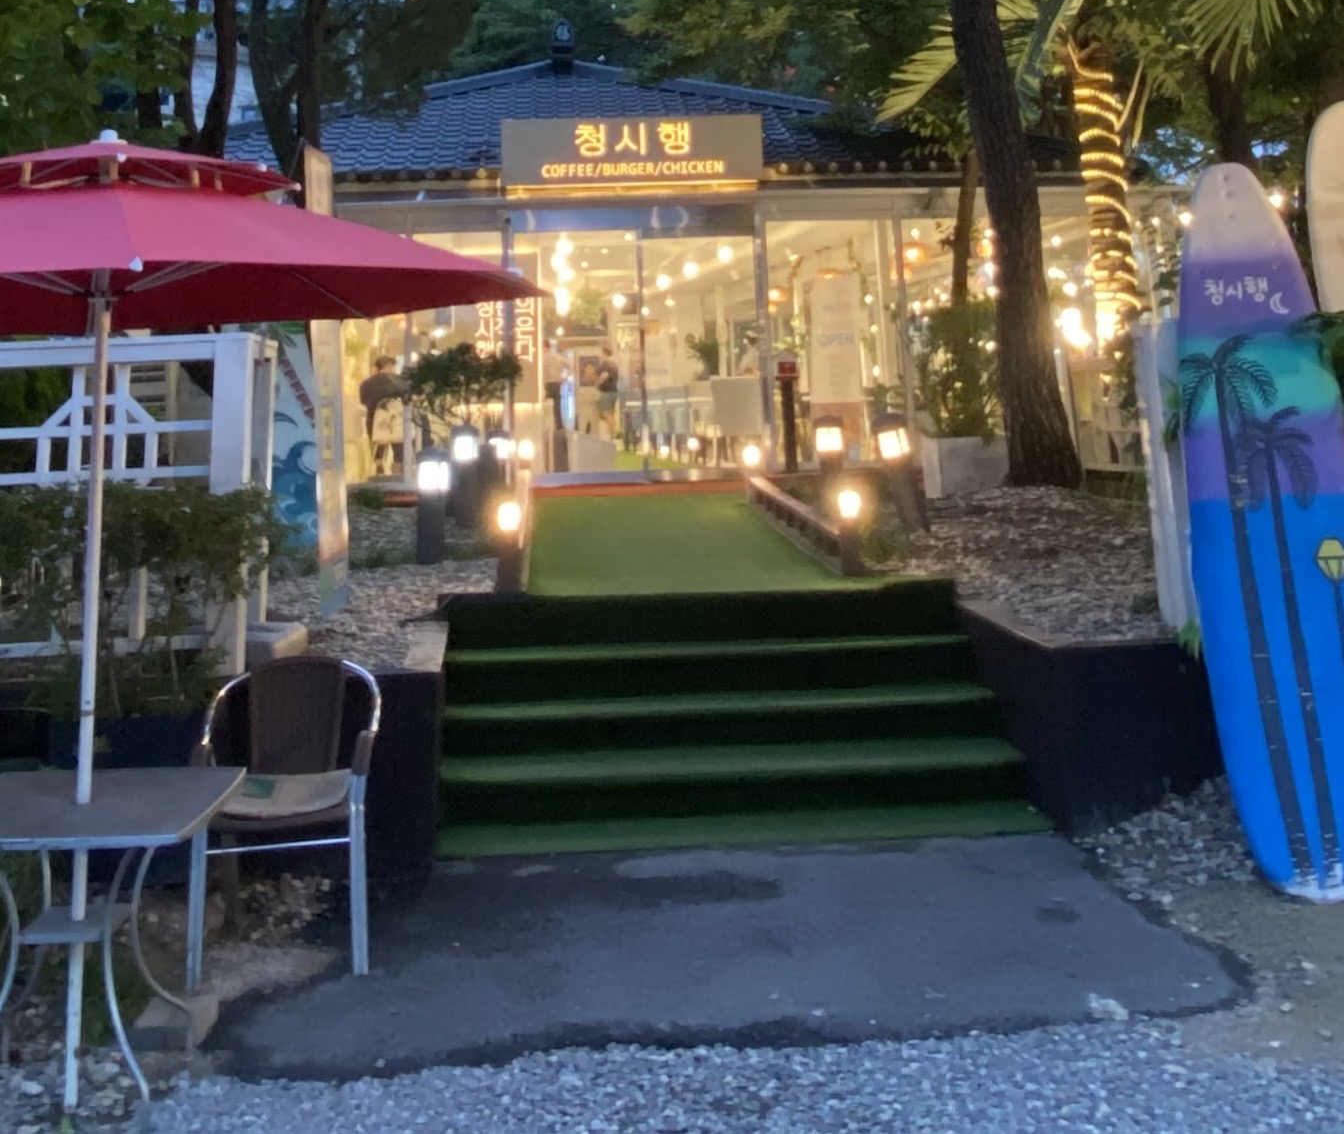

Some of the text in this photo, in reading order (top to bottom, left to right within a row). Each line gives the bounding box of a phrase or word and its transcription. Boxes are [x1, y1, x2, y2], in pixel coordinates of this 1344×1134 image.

[575, 121, 691, 157] 청시행
[541, 160, 725, 178] COFFEE/BURGER/CHICKEN
[1204, 276, 1269, 306] 청시행
